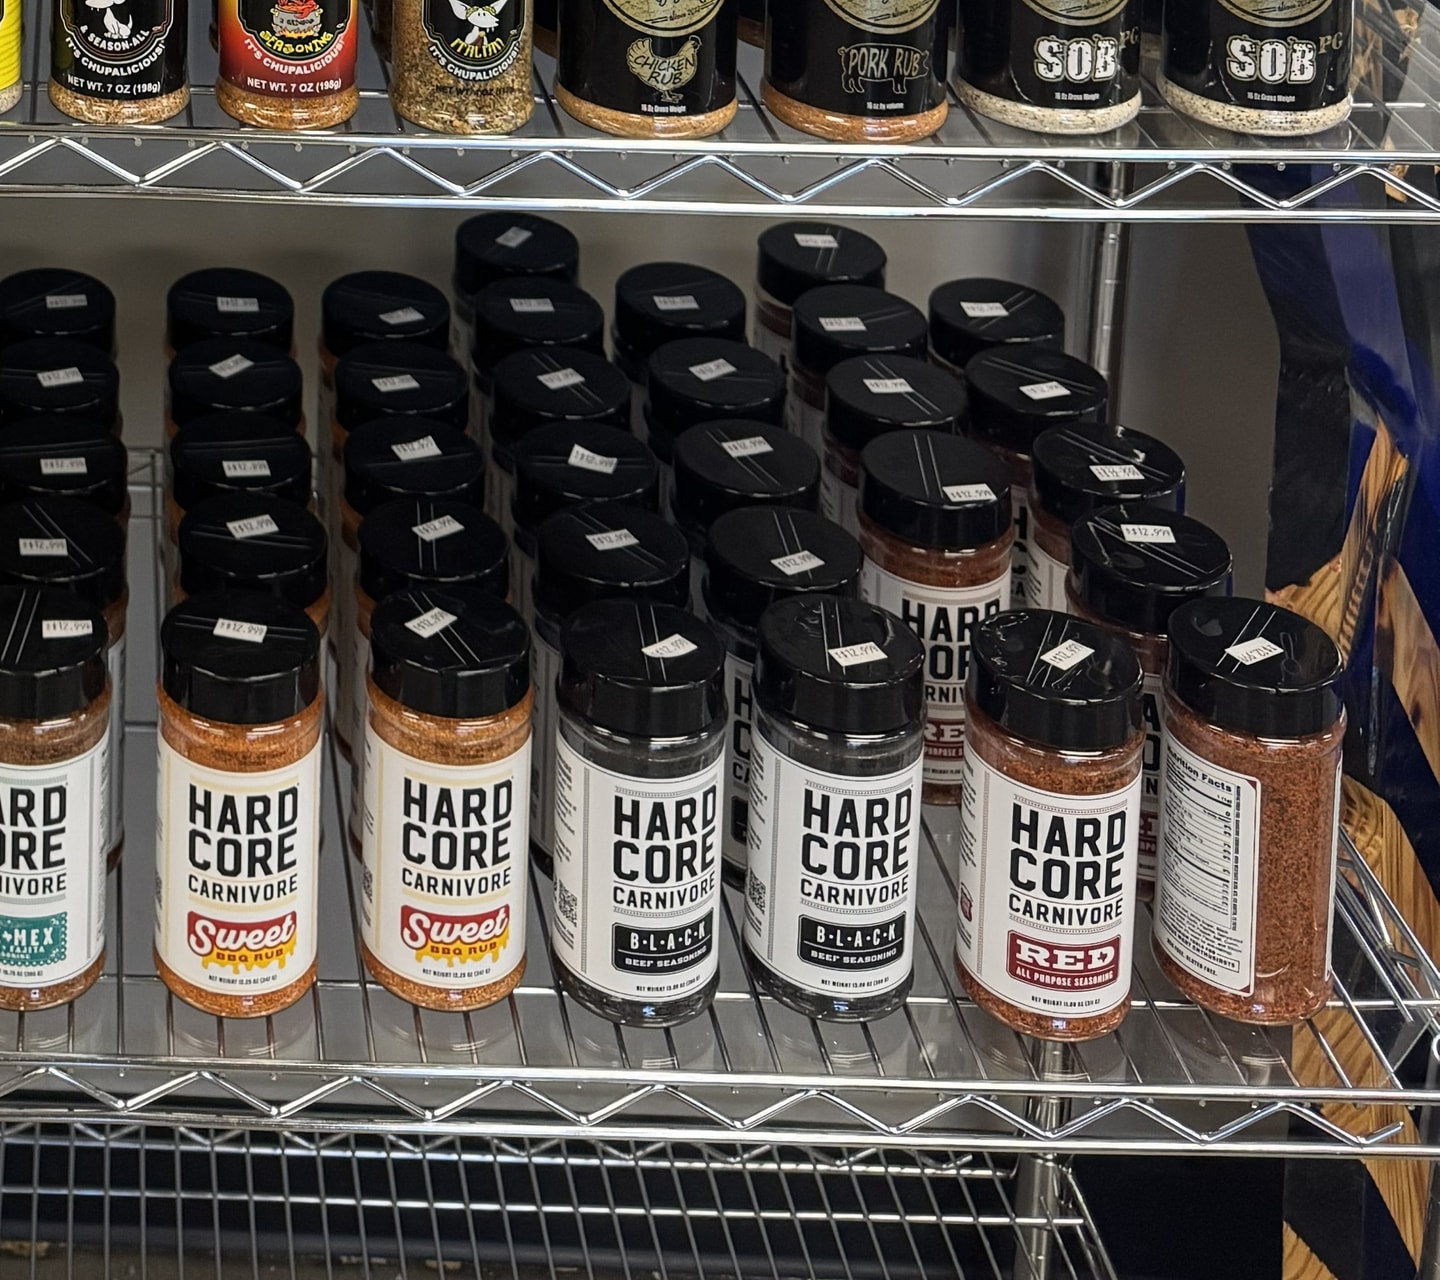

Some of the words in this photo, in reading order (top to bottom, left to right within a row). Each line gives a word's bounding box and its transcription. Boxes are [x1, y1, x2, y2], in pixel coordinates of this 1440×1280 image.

[848, 47, 888, 79] PORK
[894, 49, 920, 78] RUB
[1225, 34, 1317, 84] SOB
[1201, 773, 1233, 793] Facts
[612, 870, 716, 910] CARNIVORE
[189, 910, 296, 957] Sweet
[215, 950, 249, 963] BBQ
[254, 948, 285, 961] RUB
[624, 956, 654, 968] BEEF
[656, 944, 708, 969] SEASONING
[1014, 938, 1116, 970] RED
[1015, 966, 1032, 980] ALL
[1033, 969, 1071, 987] PURPOSE
[1073, 969, 1114, 987] SEASONING
